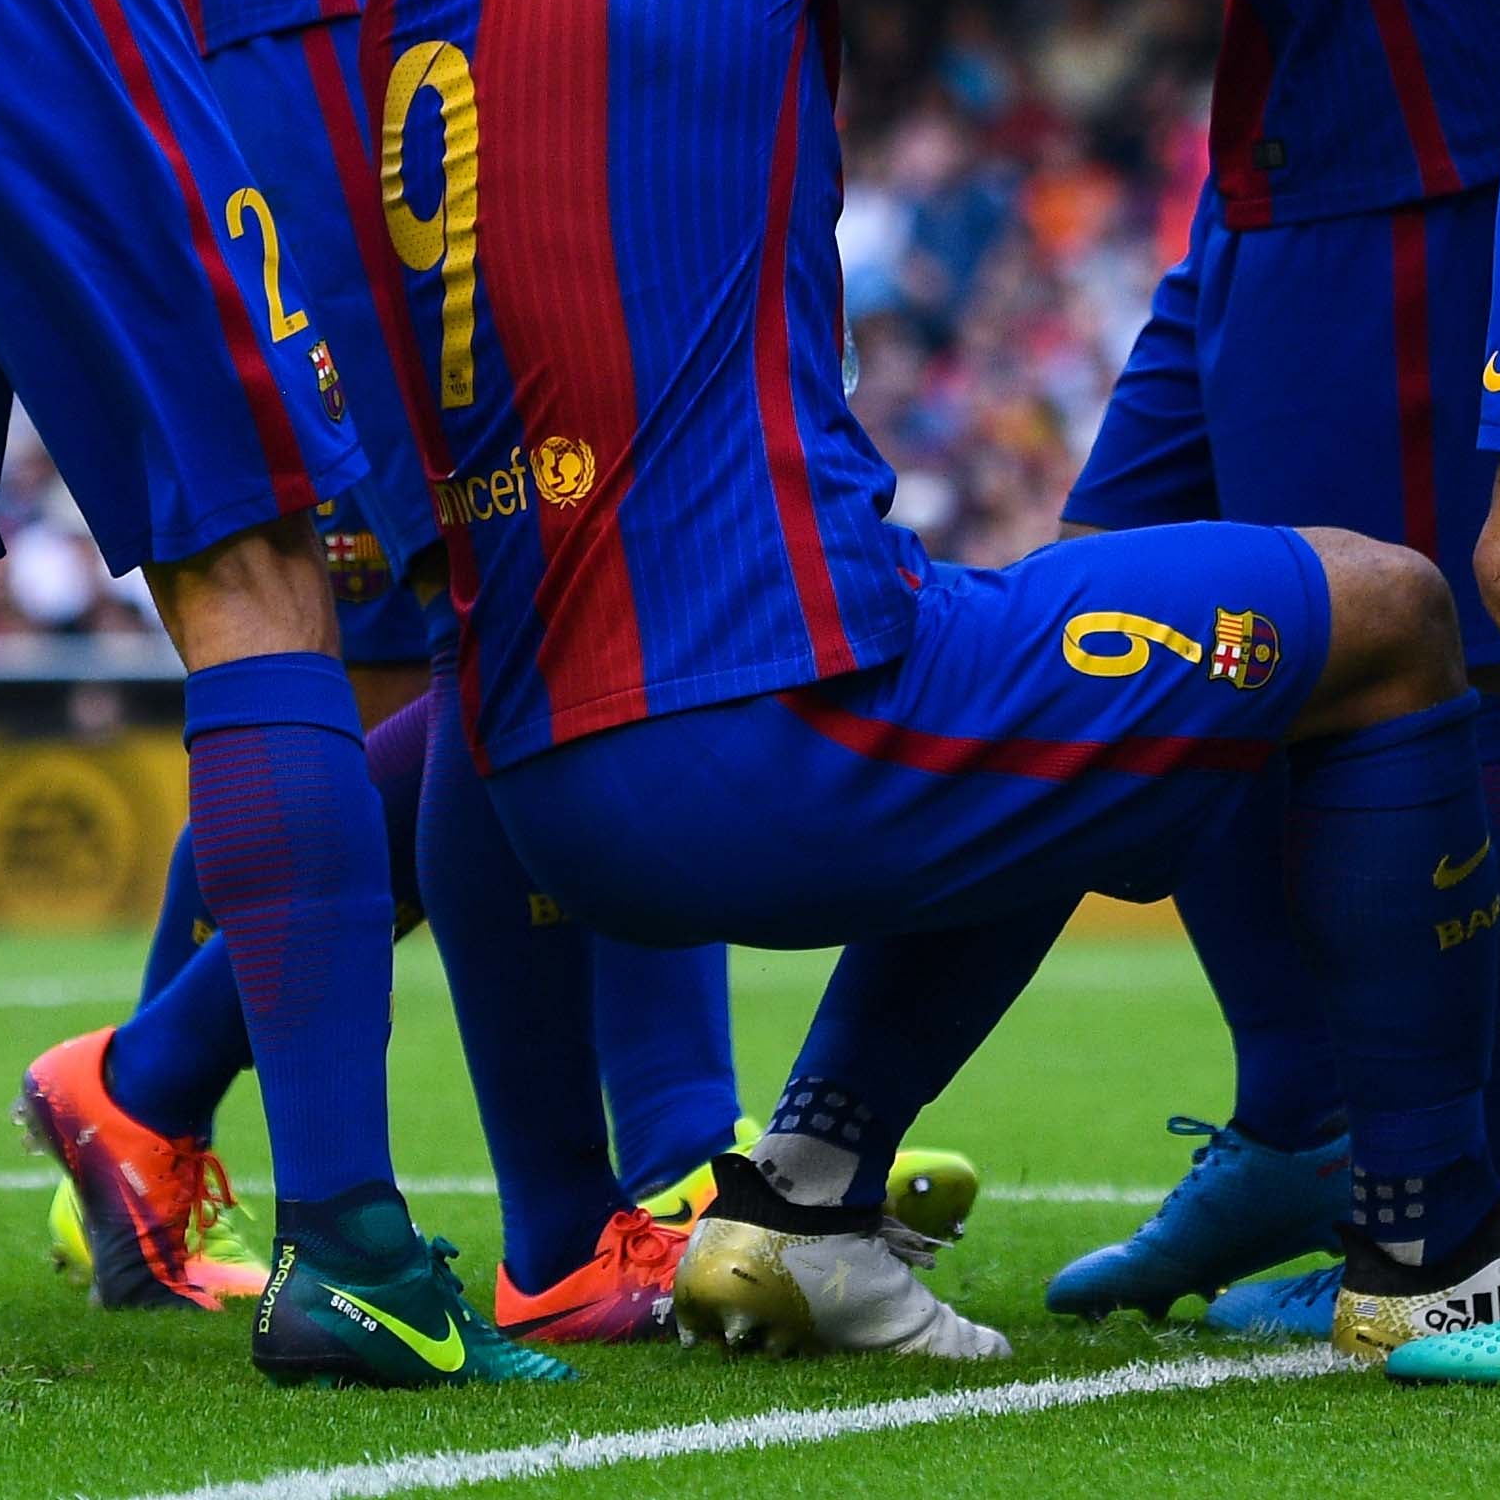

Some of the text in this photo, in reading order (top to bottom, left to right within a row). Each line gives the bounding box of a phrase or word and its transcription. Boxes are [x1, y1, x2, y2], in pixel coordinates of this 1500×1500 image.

[381, 40, 480, 410] 9
[330, 1294, 378, 1332] SERGI 20
